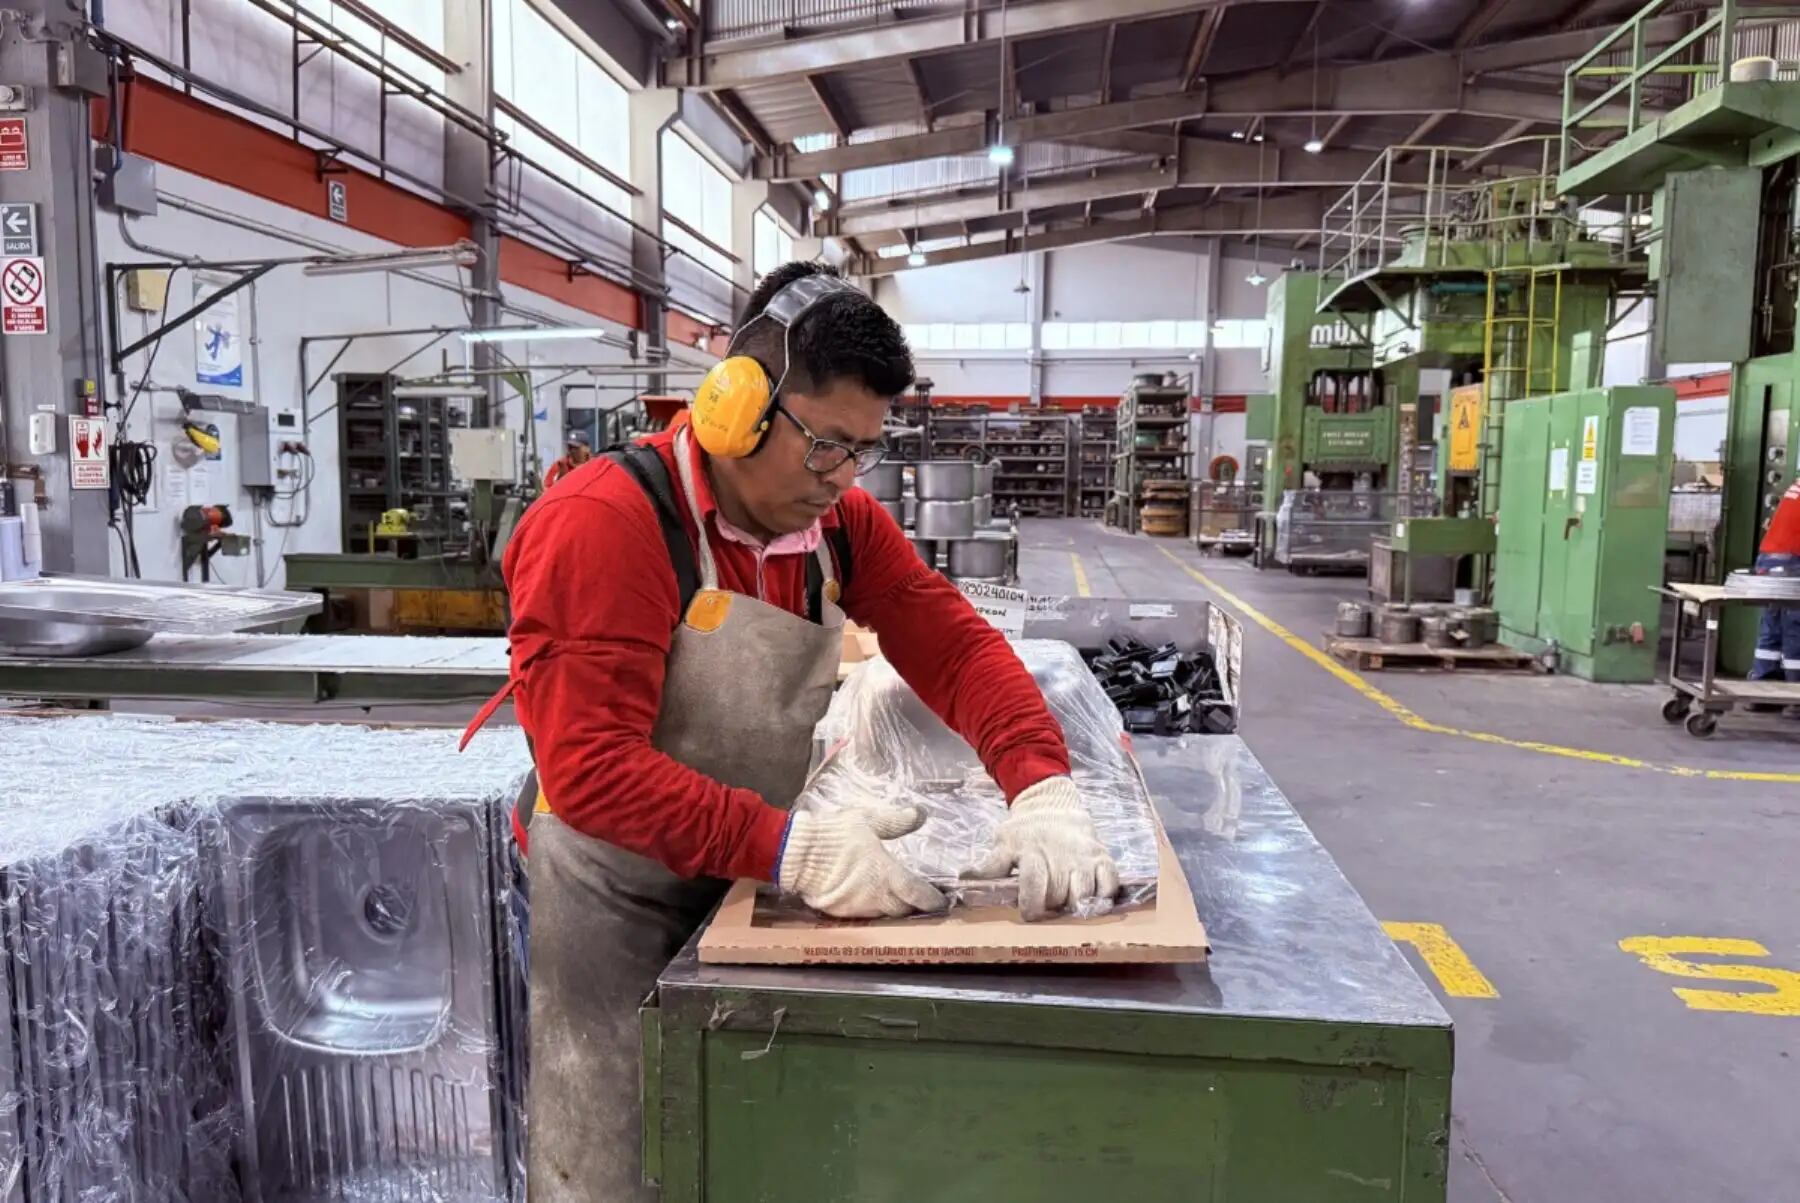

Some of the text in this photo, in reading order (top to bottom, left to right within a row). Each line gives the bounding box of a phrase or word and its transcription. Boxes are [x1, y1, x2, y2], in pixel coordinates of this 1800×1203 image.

[5, 241, 32, 250] SALIDA
[862, 947, 874, 956] CM
[927, 947, 940, 956] CM
